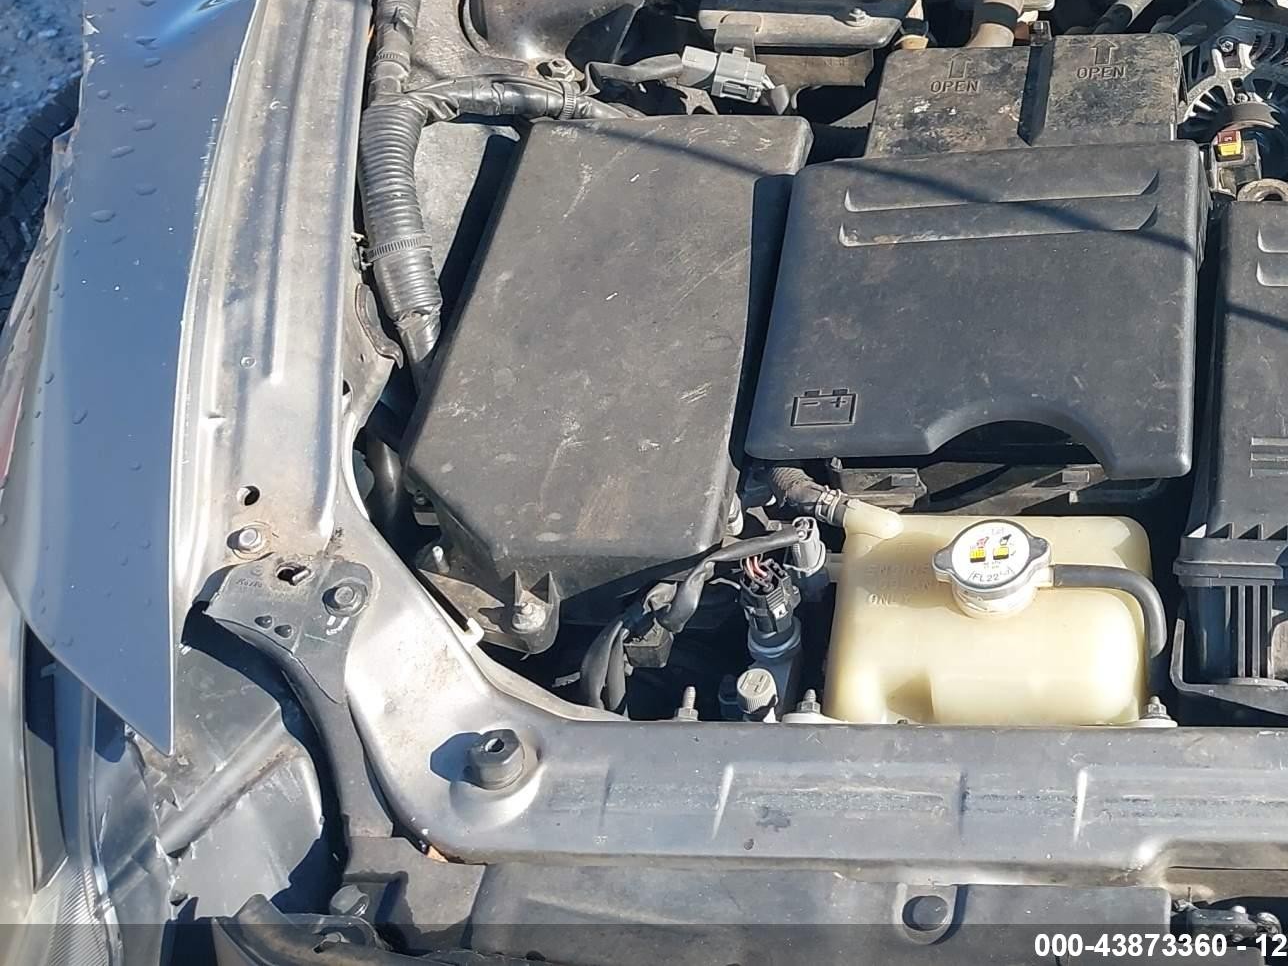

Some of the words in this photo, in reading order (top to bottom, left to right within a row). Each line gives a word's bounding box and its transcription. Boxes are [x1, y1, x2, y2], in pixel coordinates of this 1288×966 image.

[1076, 65, 1126, 80] OPEN
[930, 80, 980, 94] OPEN
[868, 593, 912, 606] ONLY
